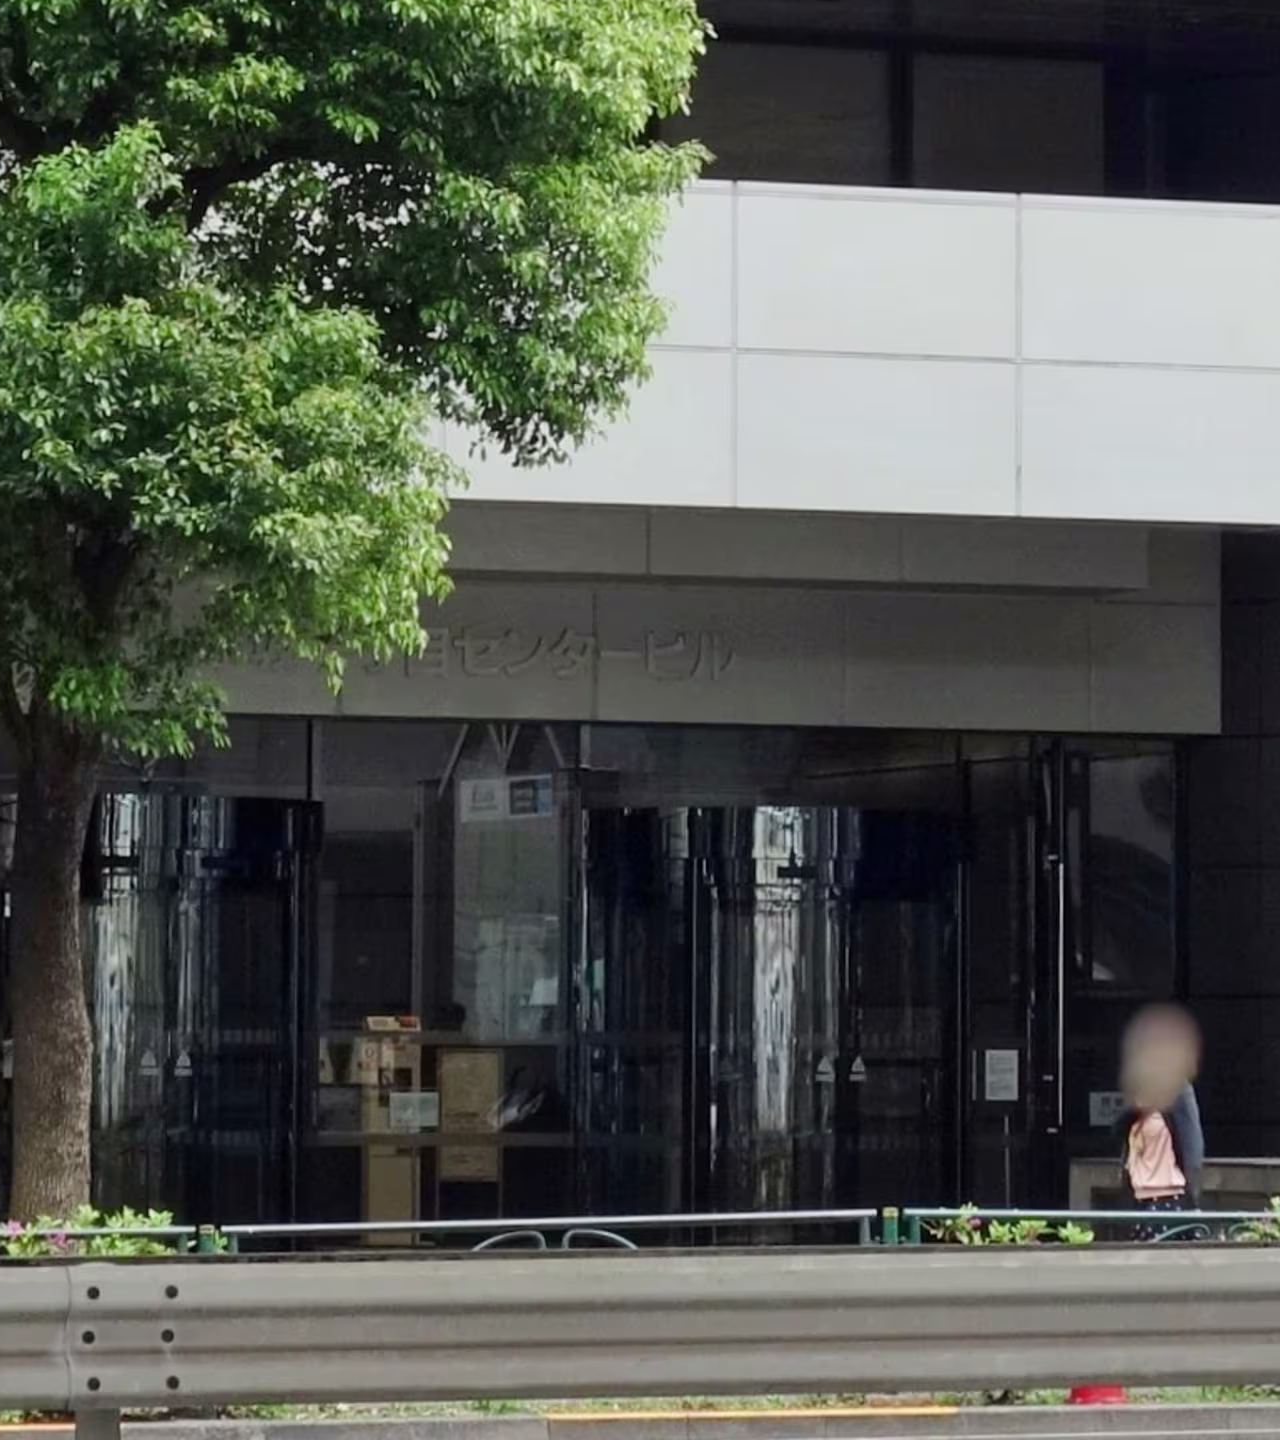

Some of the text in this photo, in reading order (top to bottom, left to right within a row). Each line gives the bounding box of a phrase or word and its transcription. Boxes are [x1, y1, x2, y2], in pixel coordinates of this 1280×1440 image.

[365, 624, 738, 682] 目センタービル
